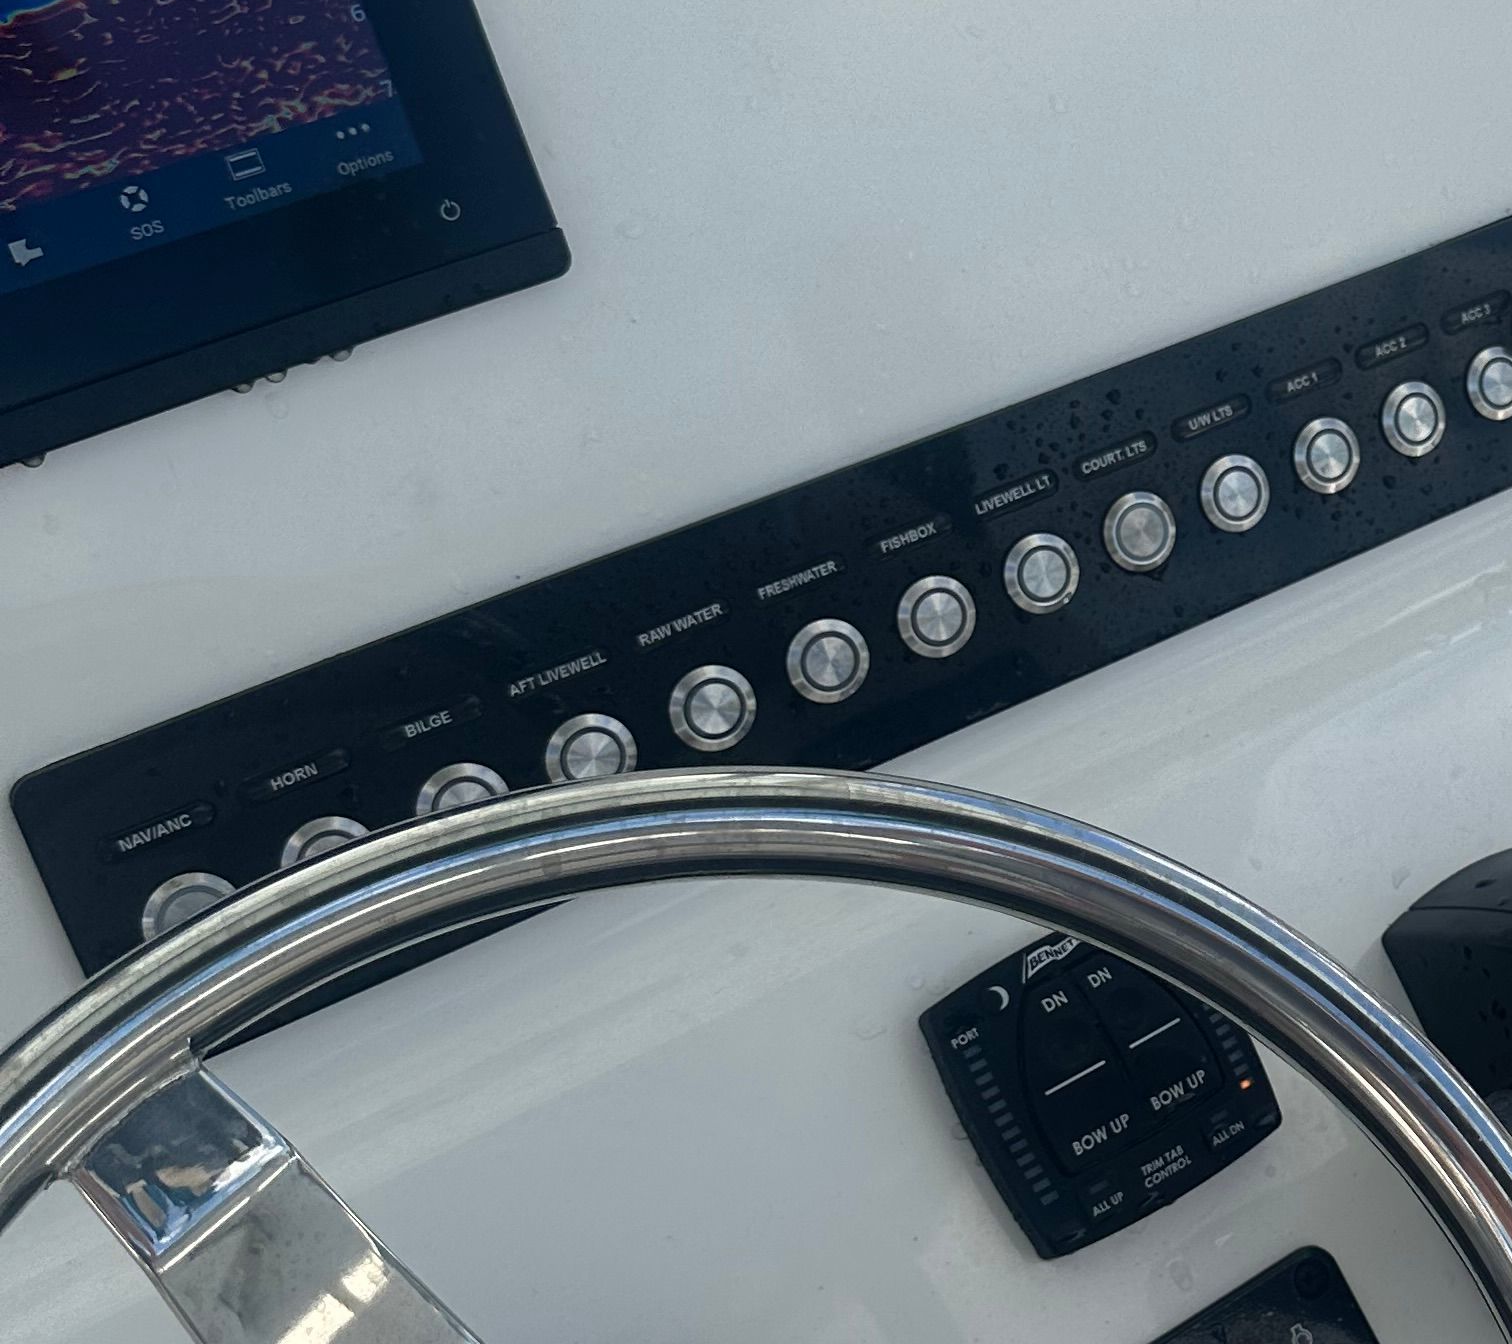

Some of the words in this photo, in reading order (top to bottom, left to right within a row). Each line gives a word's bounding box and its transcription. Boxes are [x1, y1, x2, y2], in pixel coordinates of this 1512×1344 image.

[337, 151, 394, 176] Options
[224, 183, 292, 209] Toolbars
[130, 220, 164, 240] SOS
[1462, 307, 1483, 323] ACC
[1376, 341, 1397, 356] ACC
[1288, 376, 1309, 392] ACC
[1208, 405, 1232, 421] LTS
[1125, 441, 1146, 457] LTS
[975, 483, 1035, 514] LIVEWELL
[1035, 476, 1049, 489] LT
[880, 522, 936, 553] FISHBOX
[758, 561, 837, 599] FRESHWATER
[638, 624, 671, 646] RAW
[672, 604, 722, 631] WATER
[507, 683, 539, 701] AFT
[537, 649, 608, 690] LIVEWELL
[404, 711, 452, 737] BILGE
[271, 764, 317, 790] HORN
[118, 814, 191, 851] NAV/ANC
[1088, 968, 1112, 987] DN
[1041, 991, 1068, 1012] DN
[951, 1028, 978, 1048] PORT
[1151, 1083, 1184, 1110] BOW
[1187, 1070, 1205, 1088] UP
[1073, 1126, 1107, 1155] BOW
[1110, 1114, 1129, 1133] UP
[1213, 1131, 1229, 1146] ALL
[1229, 1121, 1244, 1135] DN
[1141, 1157, 1164, 1175] TRIM
[1165, 1146, 1183, 1161] TAB
[1145, 1156, 1191, 1188] CONTROL
[1093, 1201, 1111, 1216] ALL
[1110, 1192, 1123, 1205] UP
